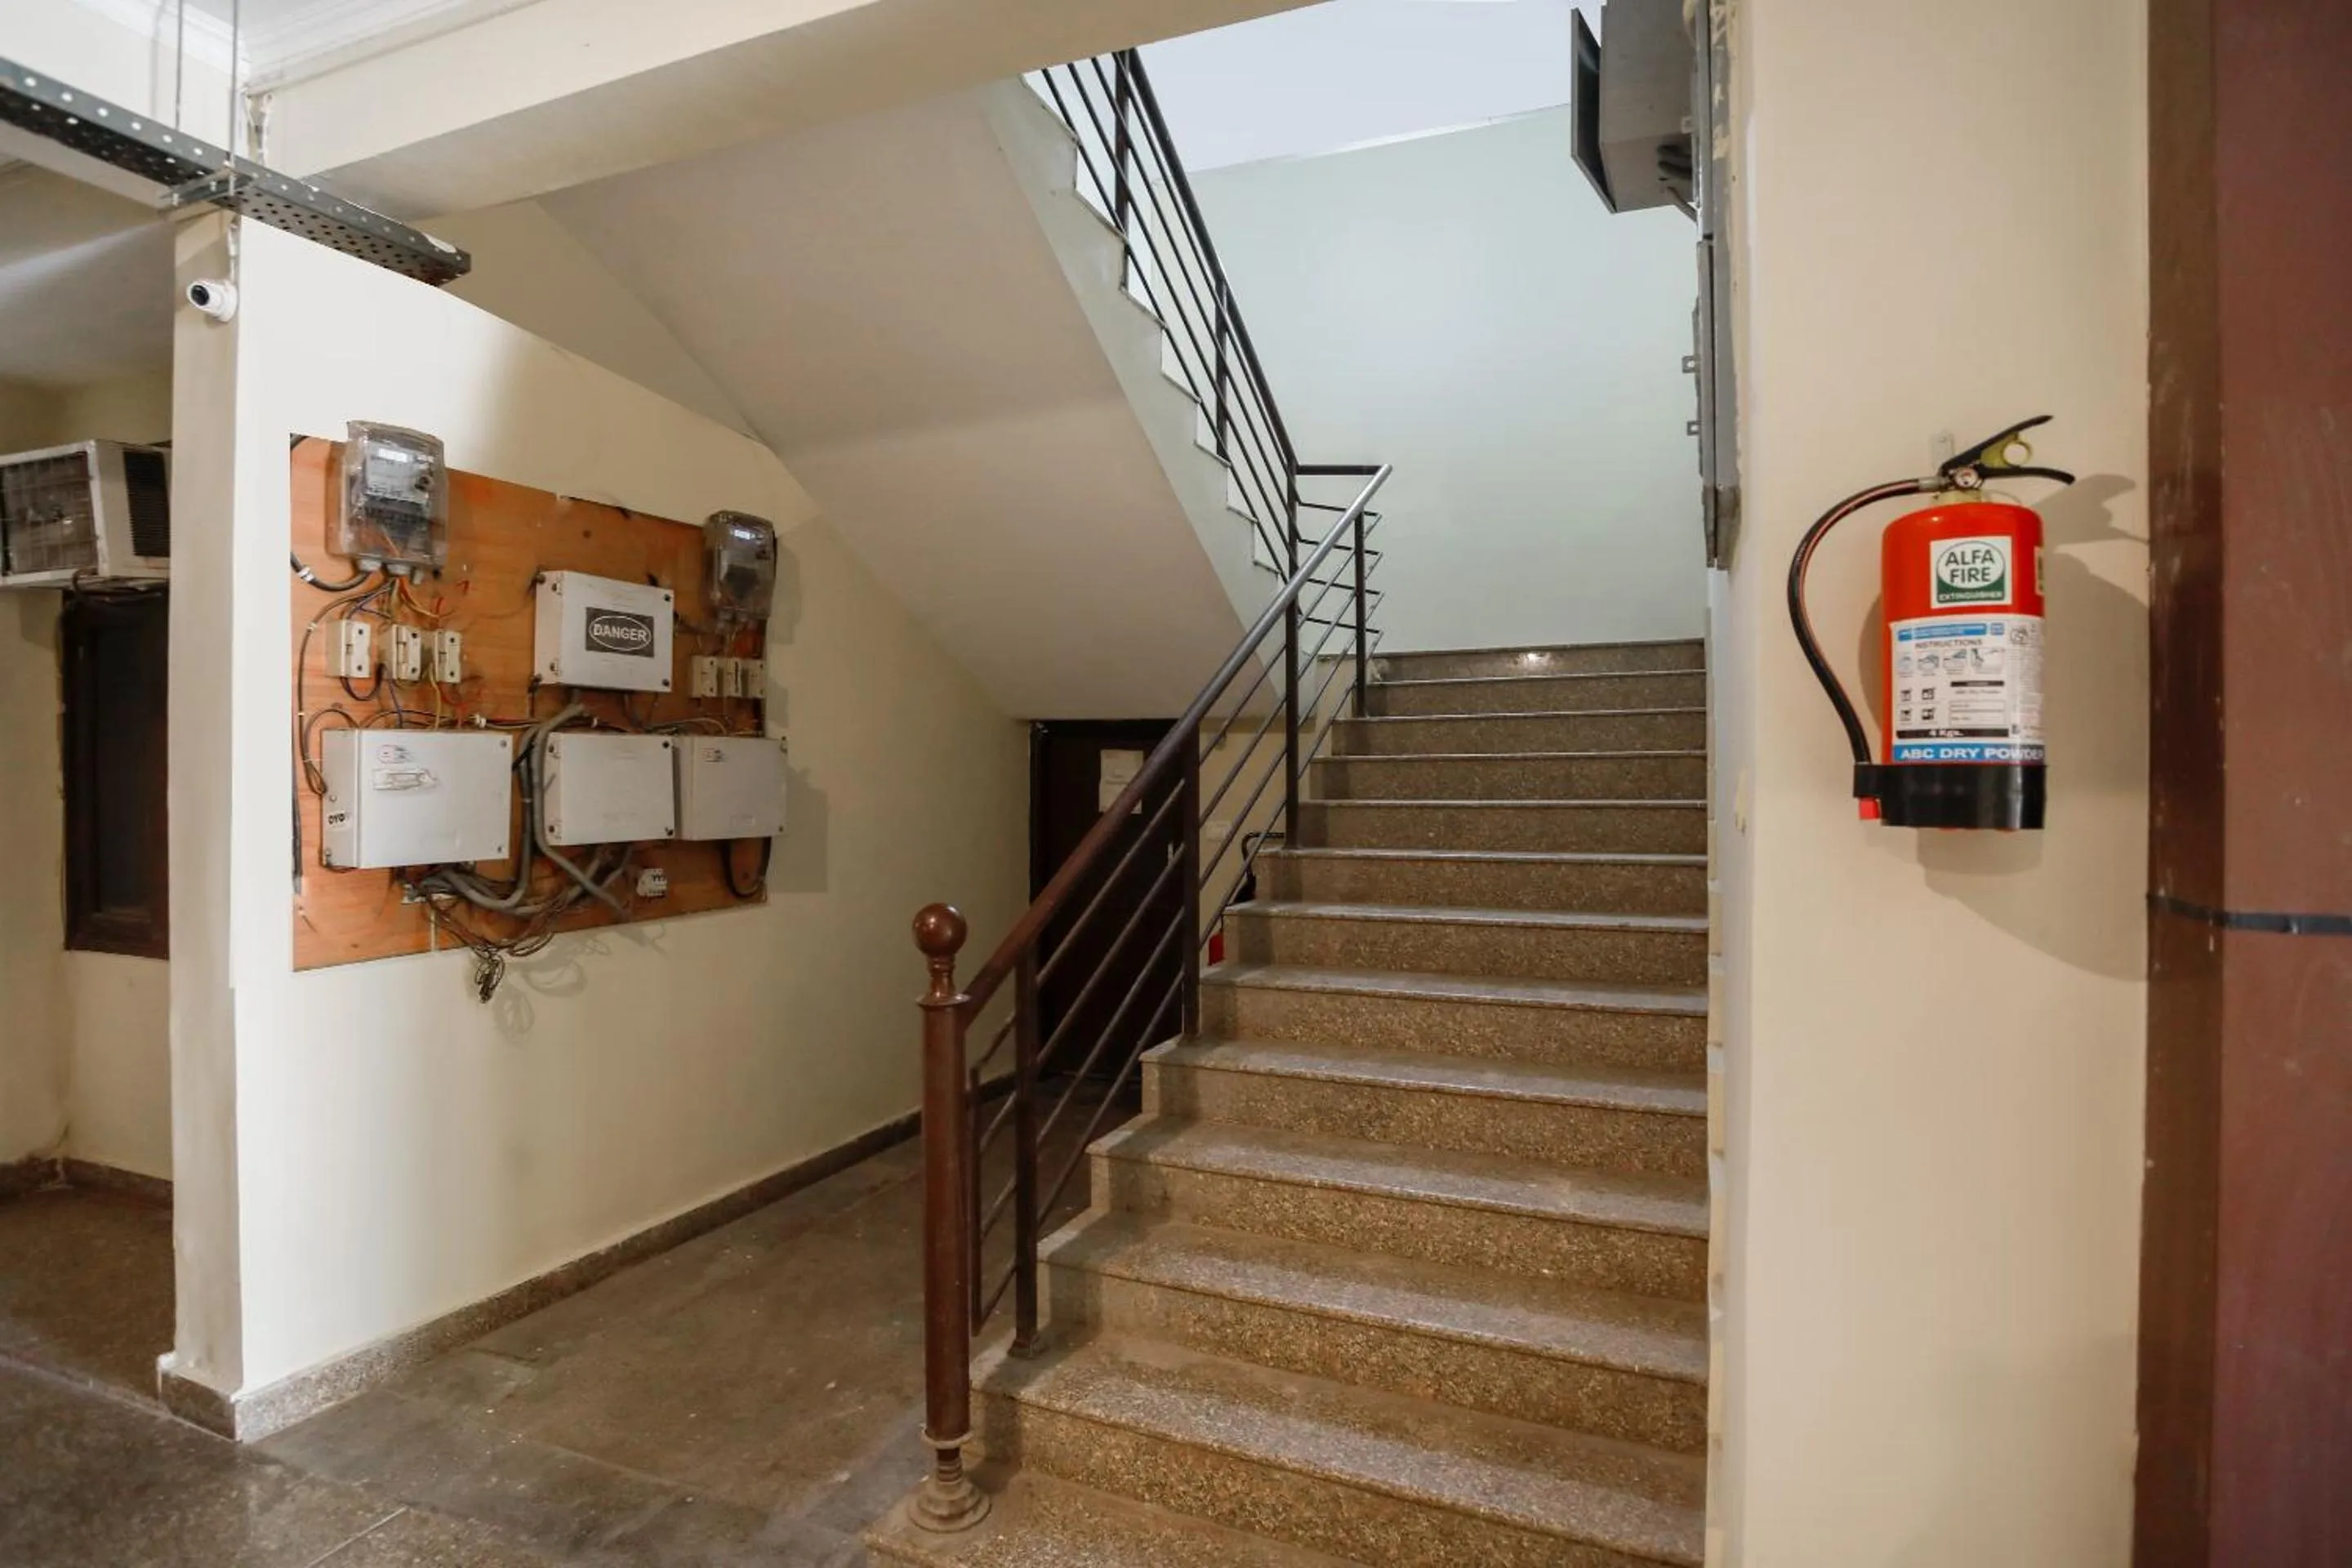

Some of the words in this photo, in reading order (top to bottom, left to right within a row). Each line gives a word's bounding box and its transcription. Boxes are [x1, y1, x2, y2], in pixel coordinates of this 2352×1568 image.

[1945, 549, 1995, 566] ALFA
[1949, 567, 1991, 583] FIRE
[594, 623, 647, 642] DANGER
[1900, 748, 1935, 759] ABC
[1939, 747, 1980, 759] DRY
